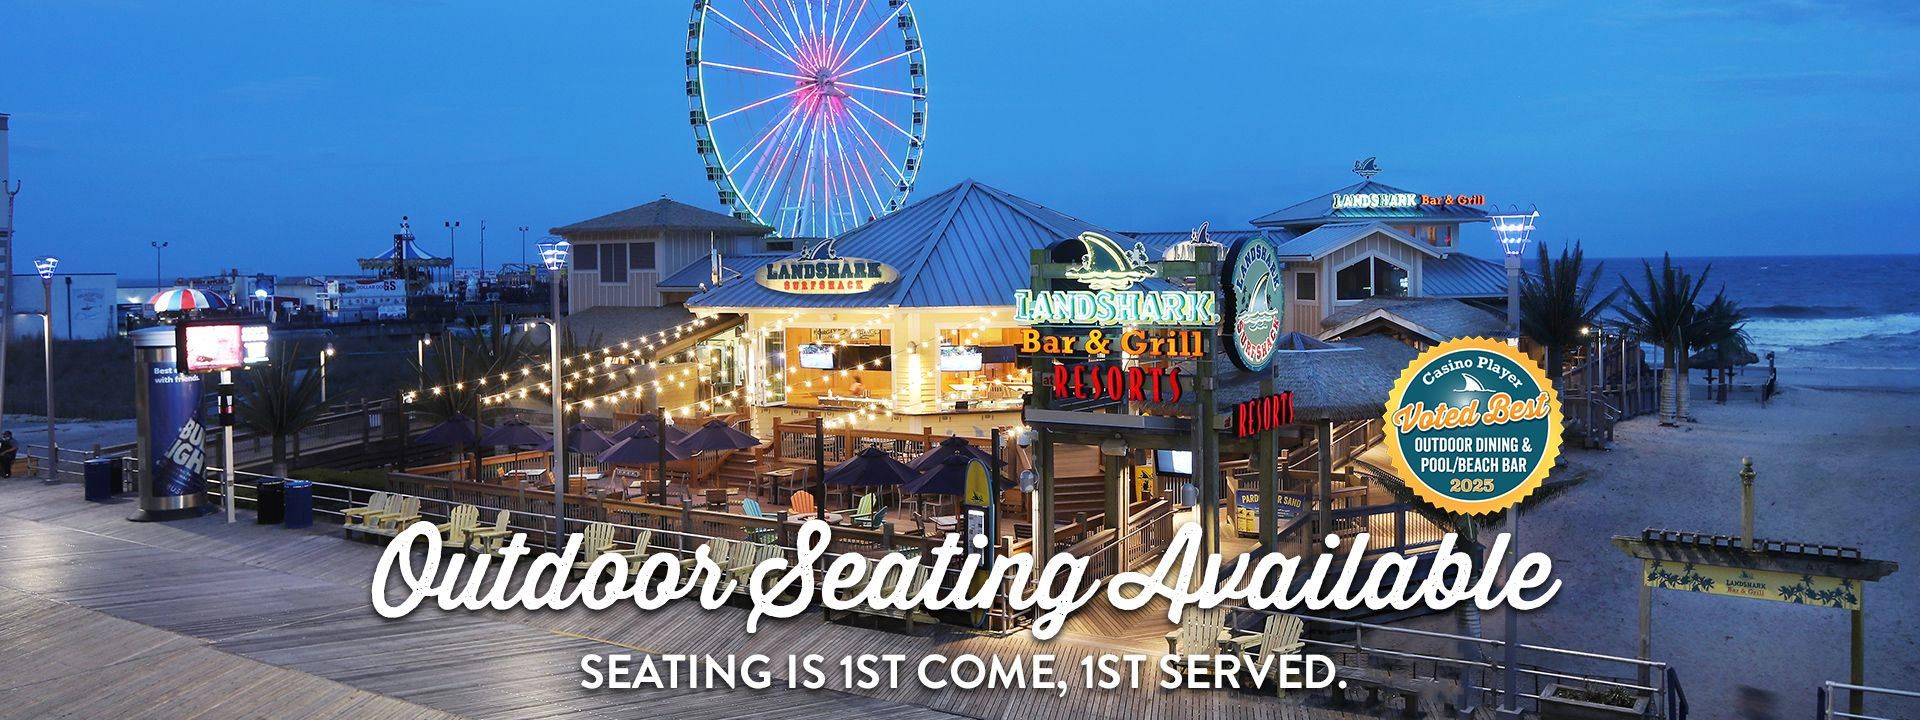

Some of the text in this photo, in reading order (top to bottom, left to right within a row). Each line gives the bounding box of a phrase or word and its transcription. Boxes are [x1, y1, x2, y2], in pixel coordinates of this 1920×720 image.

[1333, 193, 1485, 208] LANDSHARK Bar & Grill
[767, 262, 881, 279] LANDSHARK
[1236, 243, 1280, 292] LANDSHARK
[784, 281, 862, 290] SURFSHACK
[1020, 329, 1205, 357] Bar & Grill
[1237, 316, 1280, 361] SURFSHACK
[154, 376, 174, 384] with
[1054, 365, 1181, 403] RESORTS
[1239, 391, 1294, 438] RESORTS
[1284, 496, 1301, 508] SAND
[1726, 580, 1766, 590] LANDSHARK
